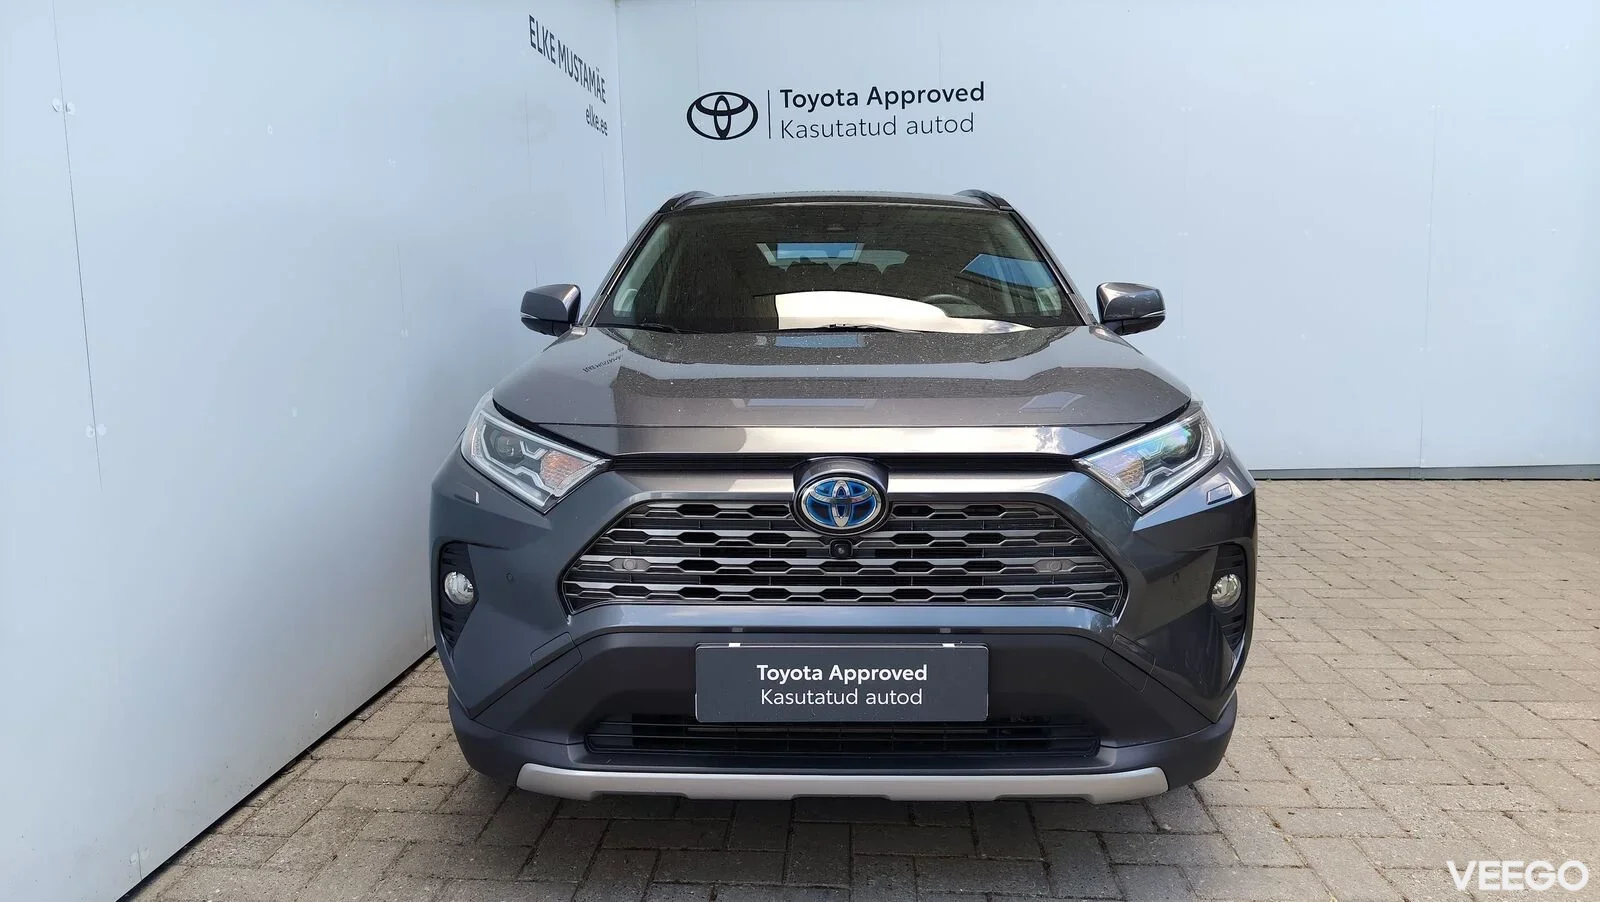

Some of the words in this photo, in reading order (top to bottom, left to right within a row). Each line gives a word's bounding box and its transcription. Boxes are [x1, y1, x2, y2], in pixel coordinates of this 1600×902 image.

[528, 14, 556, 65] ELKE
[557, 39, 607, 105] MUSTAMÄE
[779, 88, 859, 113] Toyota
[866, 81, 985, 111] Approved
[585, 103, 608, 137] elke.ee
[780, 115, 897, 140] Kasutatud
[906, 112, 975, 136] autod
[756, 664, 823, 684] Toyota
[828, 664, 928, 684] Approved
[760, 687, 859, 705] Kasutatud
[865, 687, 923, 705] autod
